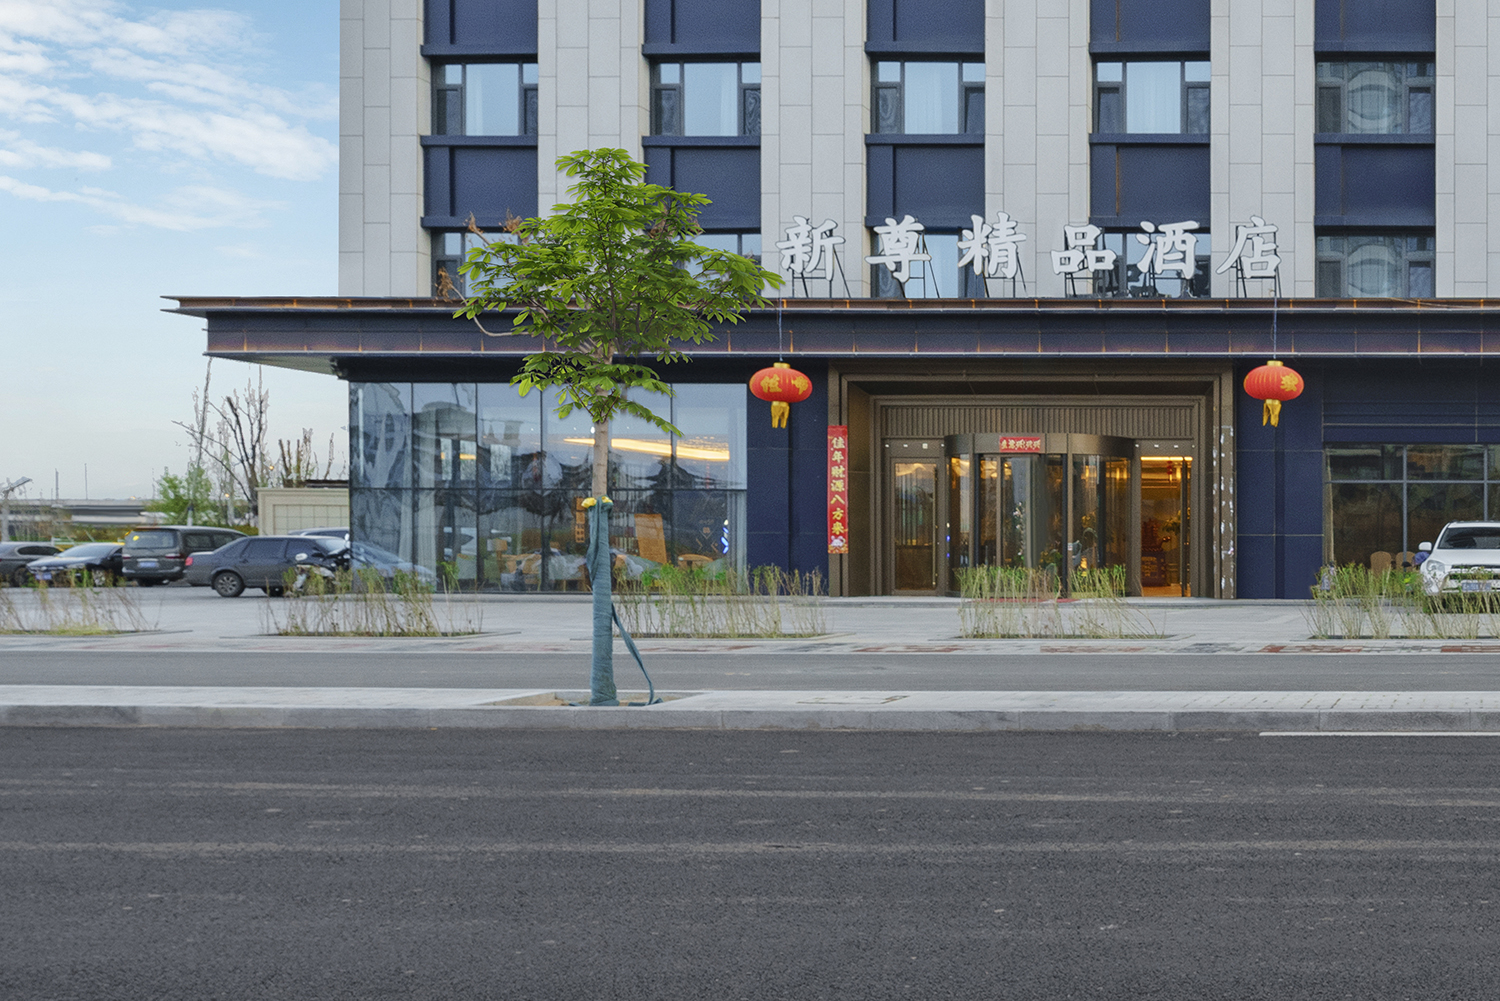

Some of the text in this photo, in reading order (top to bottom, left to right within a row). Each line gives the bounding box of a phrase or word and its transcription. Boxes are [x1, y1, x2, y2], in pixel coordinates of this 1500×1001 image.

[776, 212, 1283, 283] 新尊精品酒店
